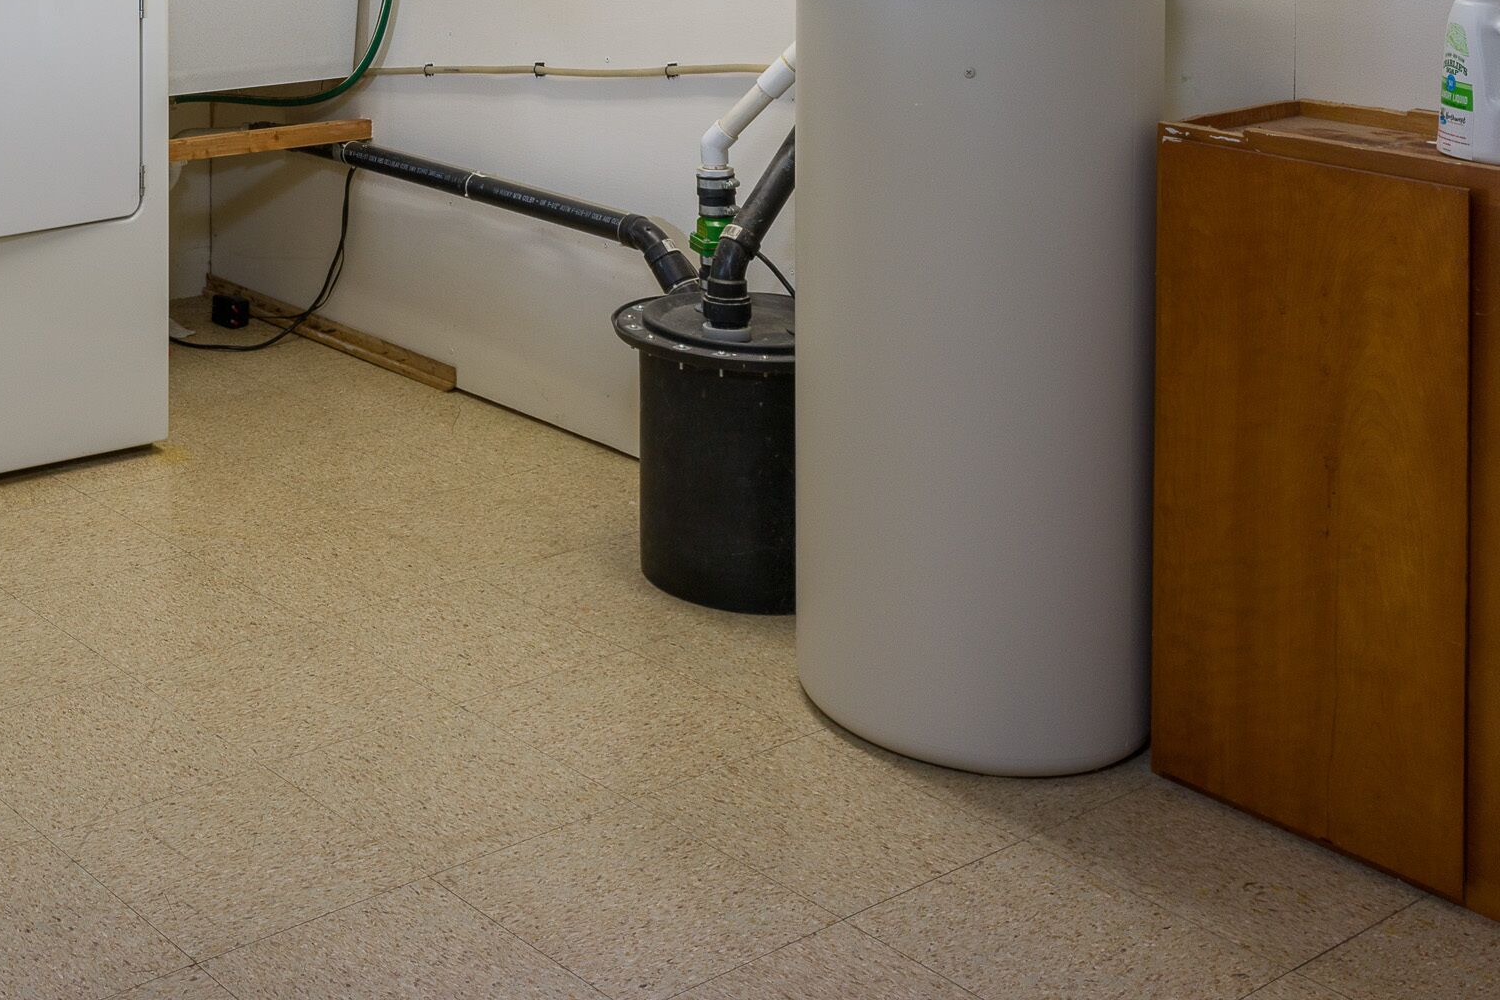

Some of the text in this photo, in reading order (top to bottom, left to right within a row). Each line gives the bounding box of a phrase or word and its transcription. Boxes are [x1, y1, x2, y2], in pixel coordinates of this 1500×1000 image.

[1445, 66, 1460, 76] SOAP
[512, 191, 522, 201] MTN
[521, 194, 535, 204] COLBY
